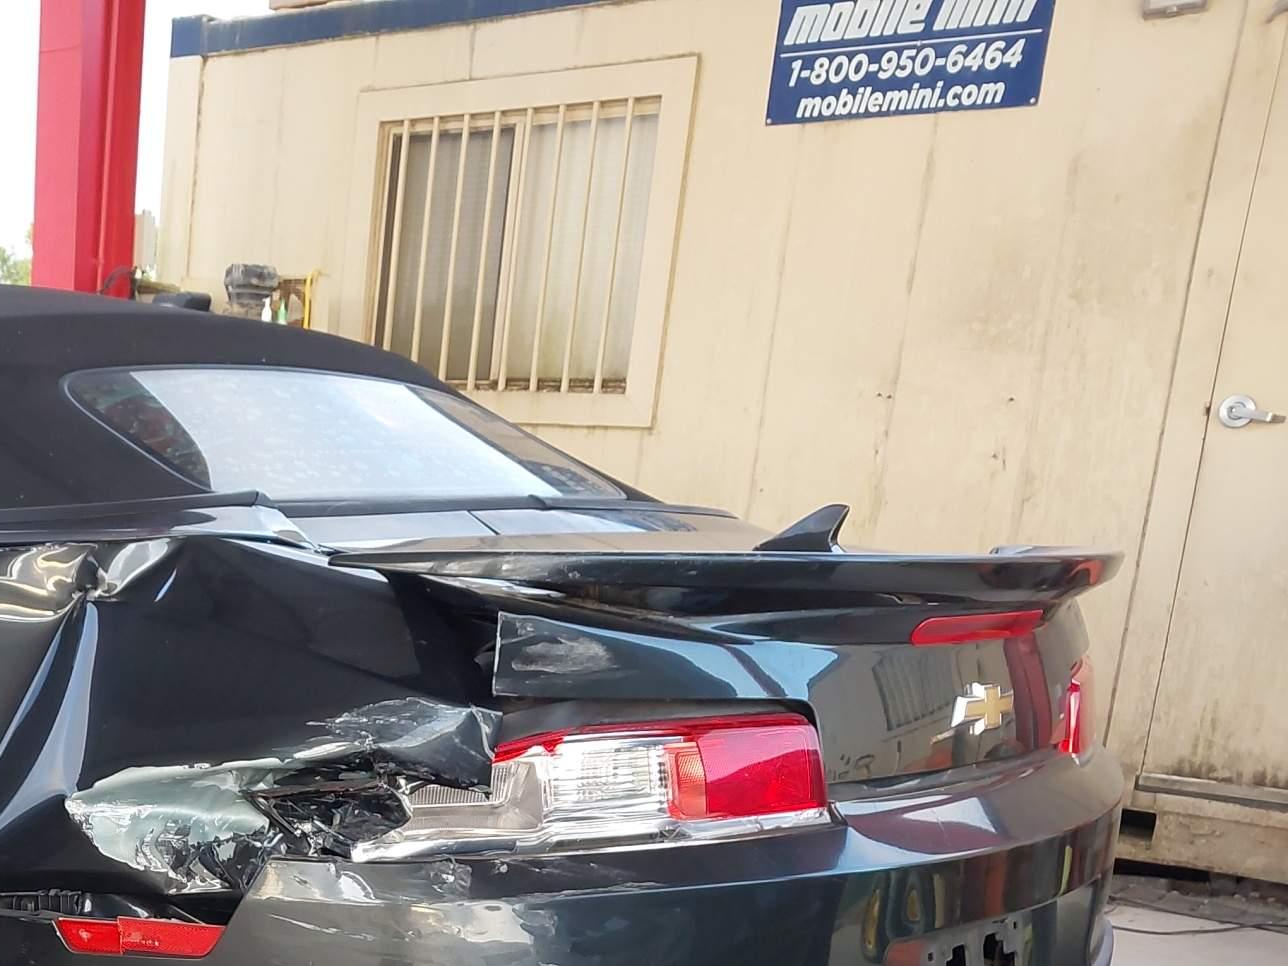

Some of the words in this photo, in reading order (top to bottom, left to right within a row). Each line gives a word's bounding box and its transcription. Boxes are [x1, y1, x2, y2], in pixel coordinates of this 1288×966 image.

[783, 0, 932, 46] mobile
[789, 38, 1026, 87] 1-800-950-6464
[796, 80, 1006, 118] mobilemini.com
